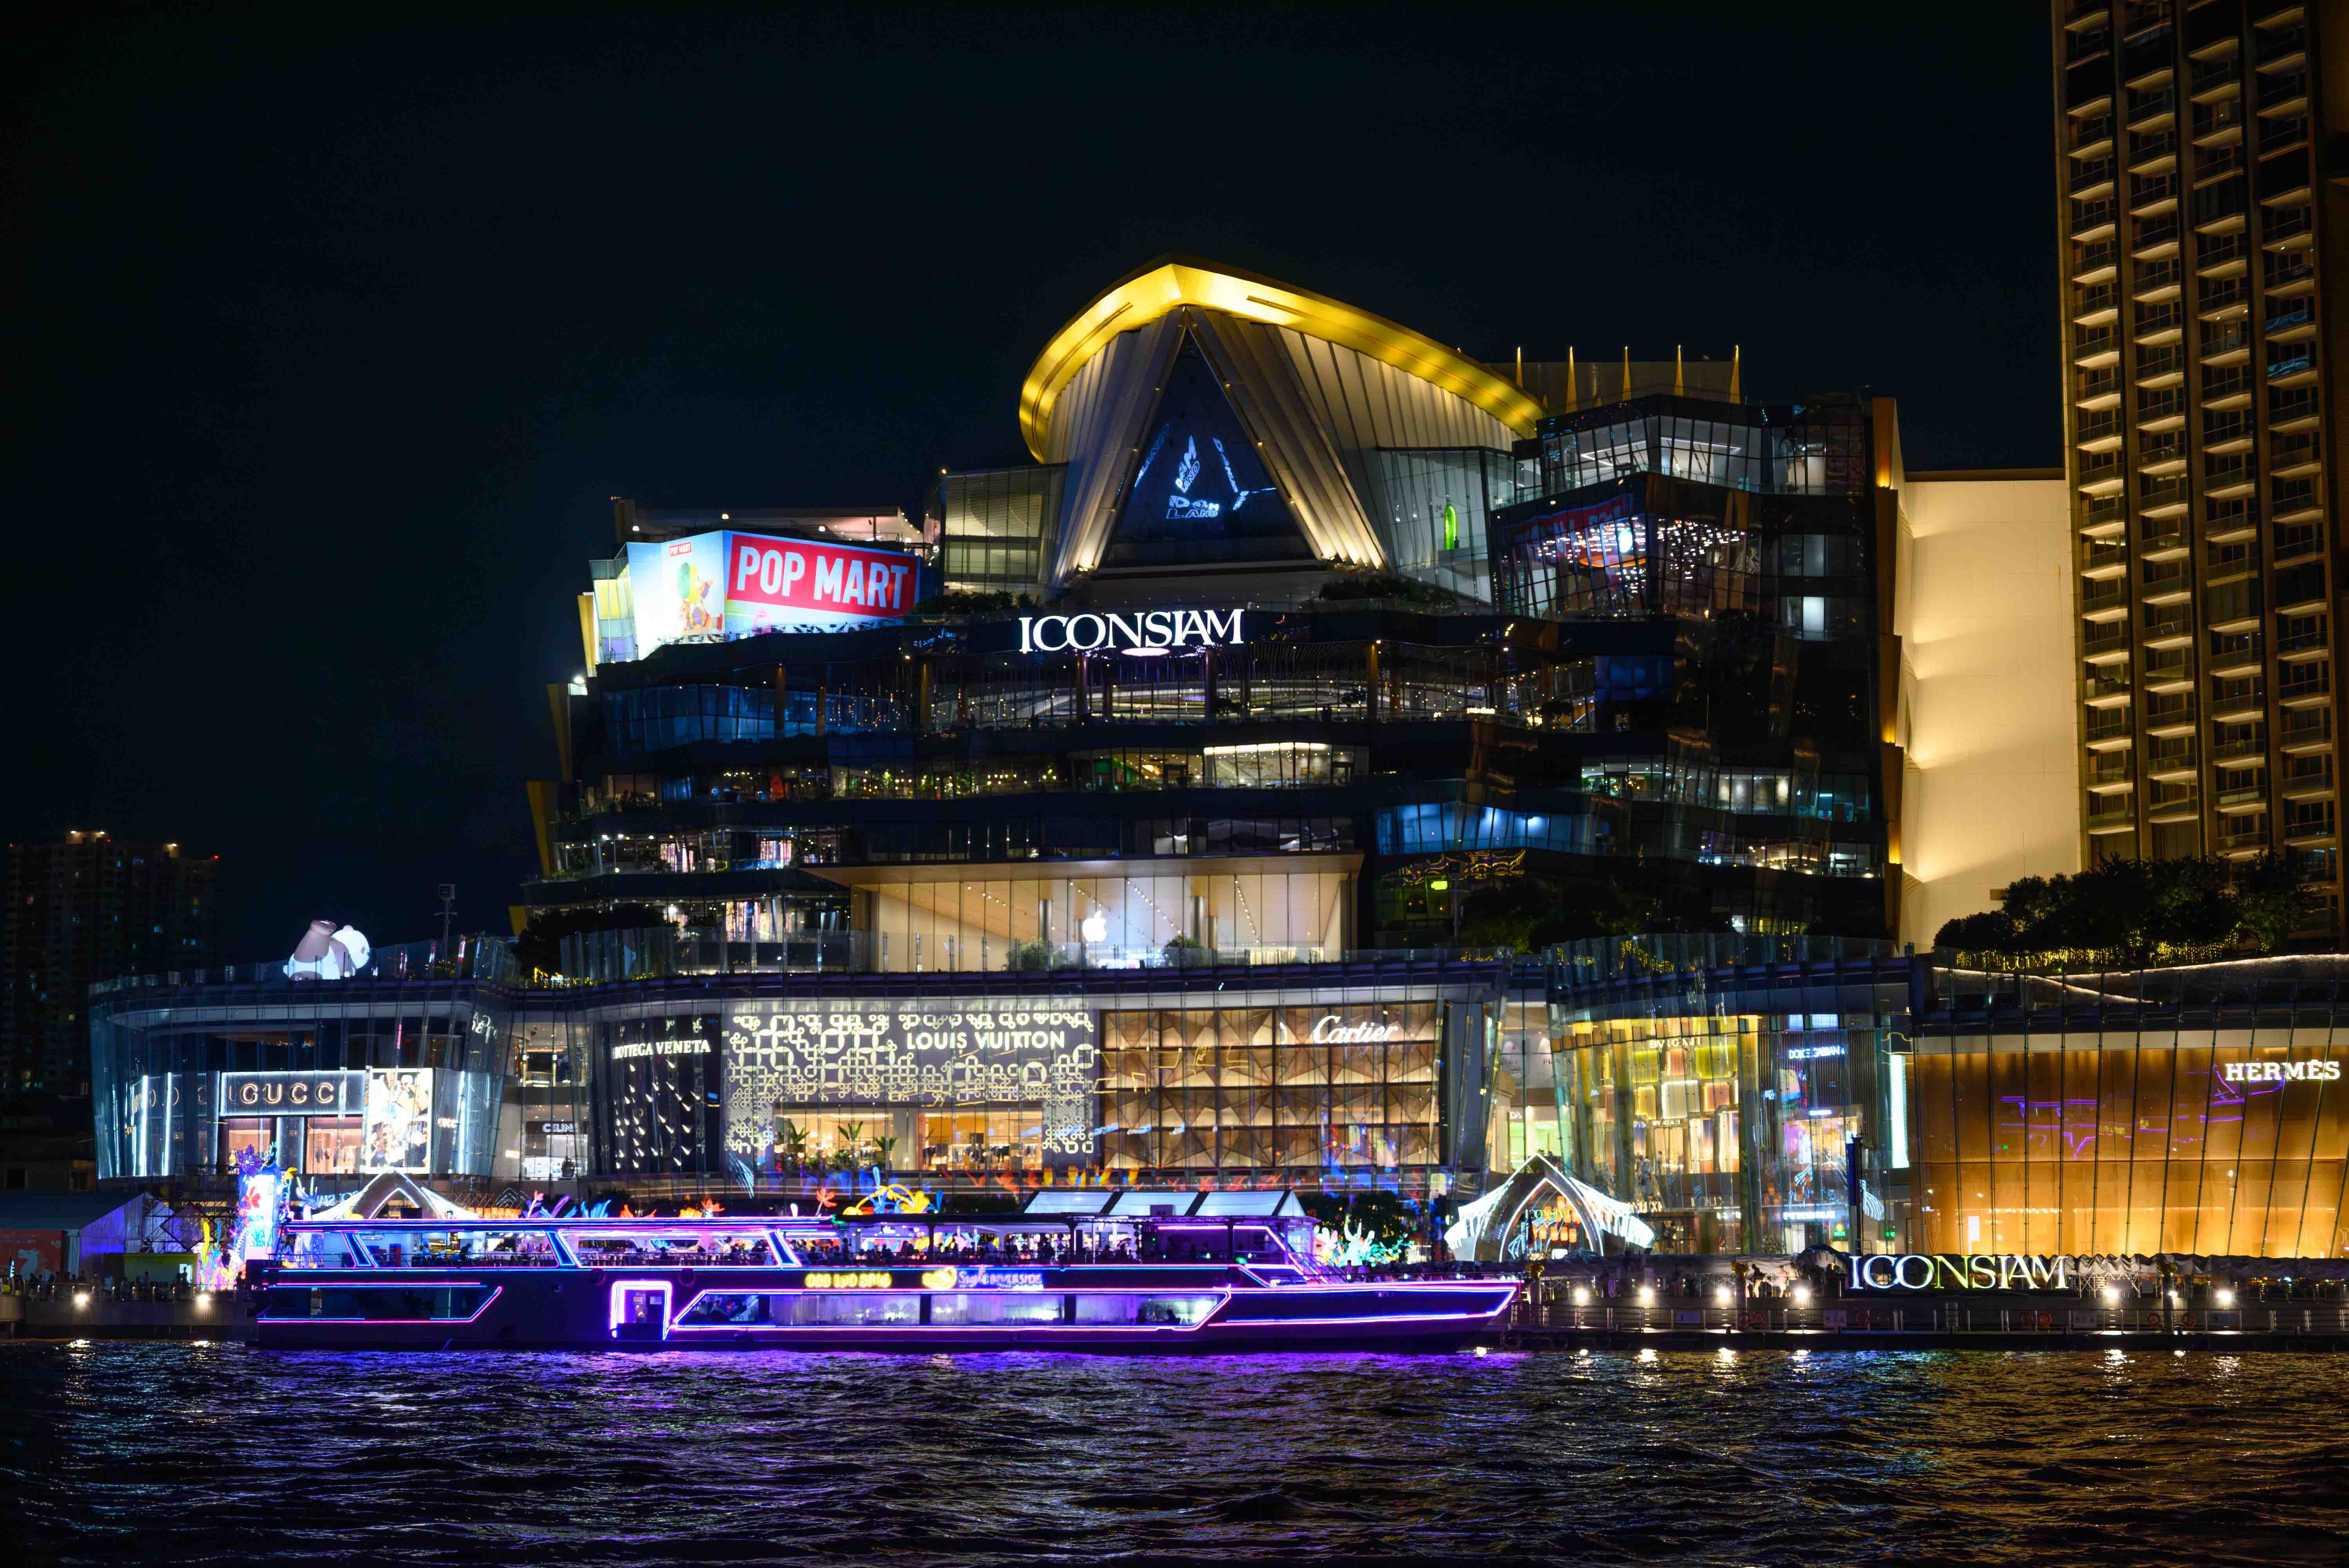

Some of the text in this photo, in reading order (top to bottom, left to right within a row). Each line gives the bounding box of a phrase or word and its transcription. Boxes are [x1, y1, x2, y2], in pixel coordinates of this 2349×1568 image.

[737, 545, 909, 609] POP MART
[1018, 608, 1245, 652] ICONSIAM
[907, 1030, 1066, 1050] LOUIS VUITTON
[1313, 1015, 1399, 1044] Cartier
[612, 1039, 712, 1060] BOTTEGA VENETA
[1849, 1254, 2069, 1290] ICONSIAM
